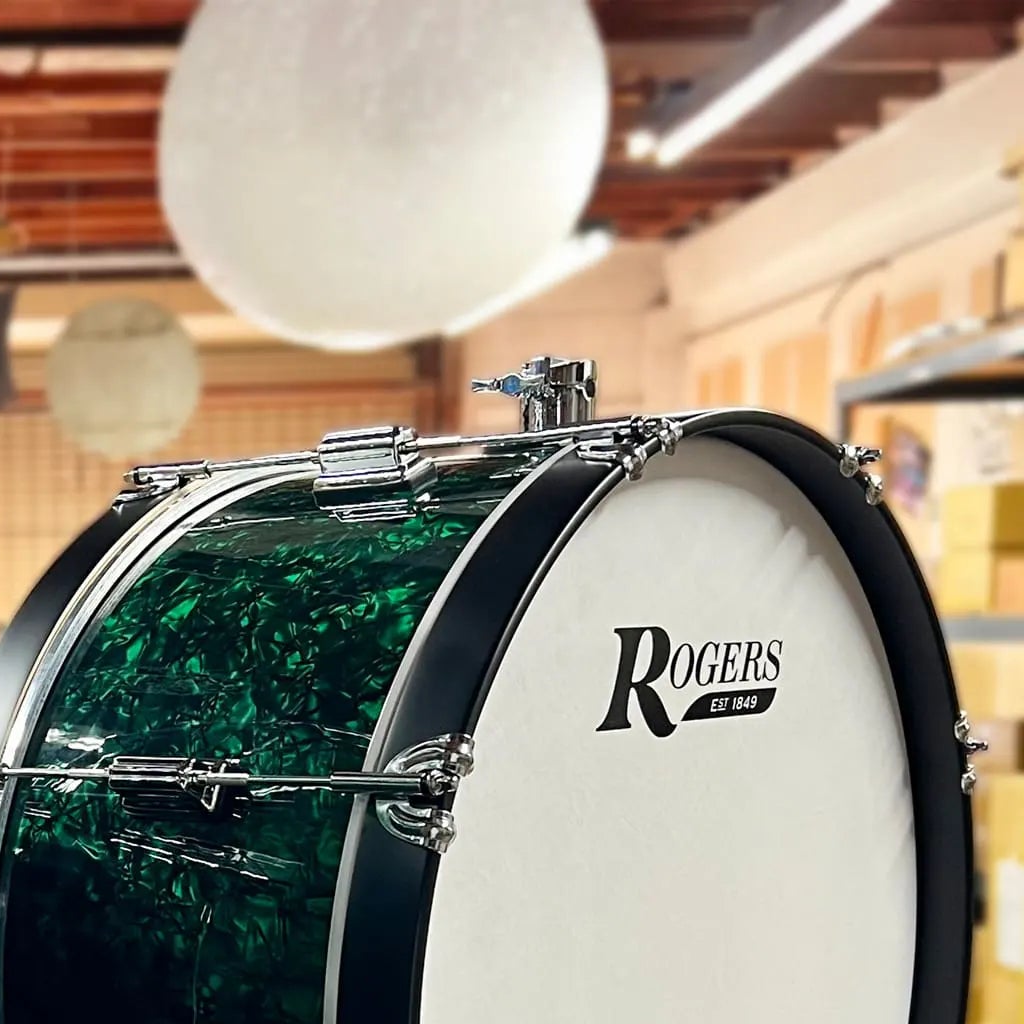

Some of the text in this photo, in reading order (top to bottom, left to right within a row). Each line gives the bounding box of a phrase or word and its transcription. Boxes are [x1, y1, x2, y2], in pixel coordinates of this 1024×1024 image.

[596, 626, 783, 738] ROGERS
[710, 695, 758, 712] EST 1849
